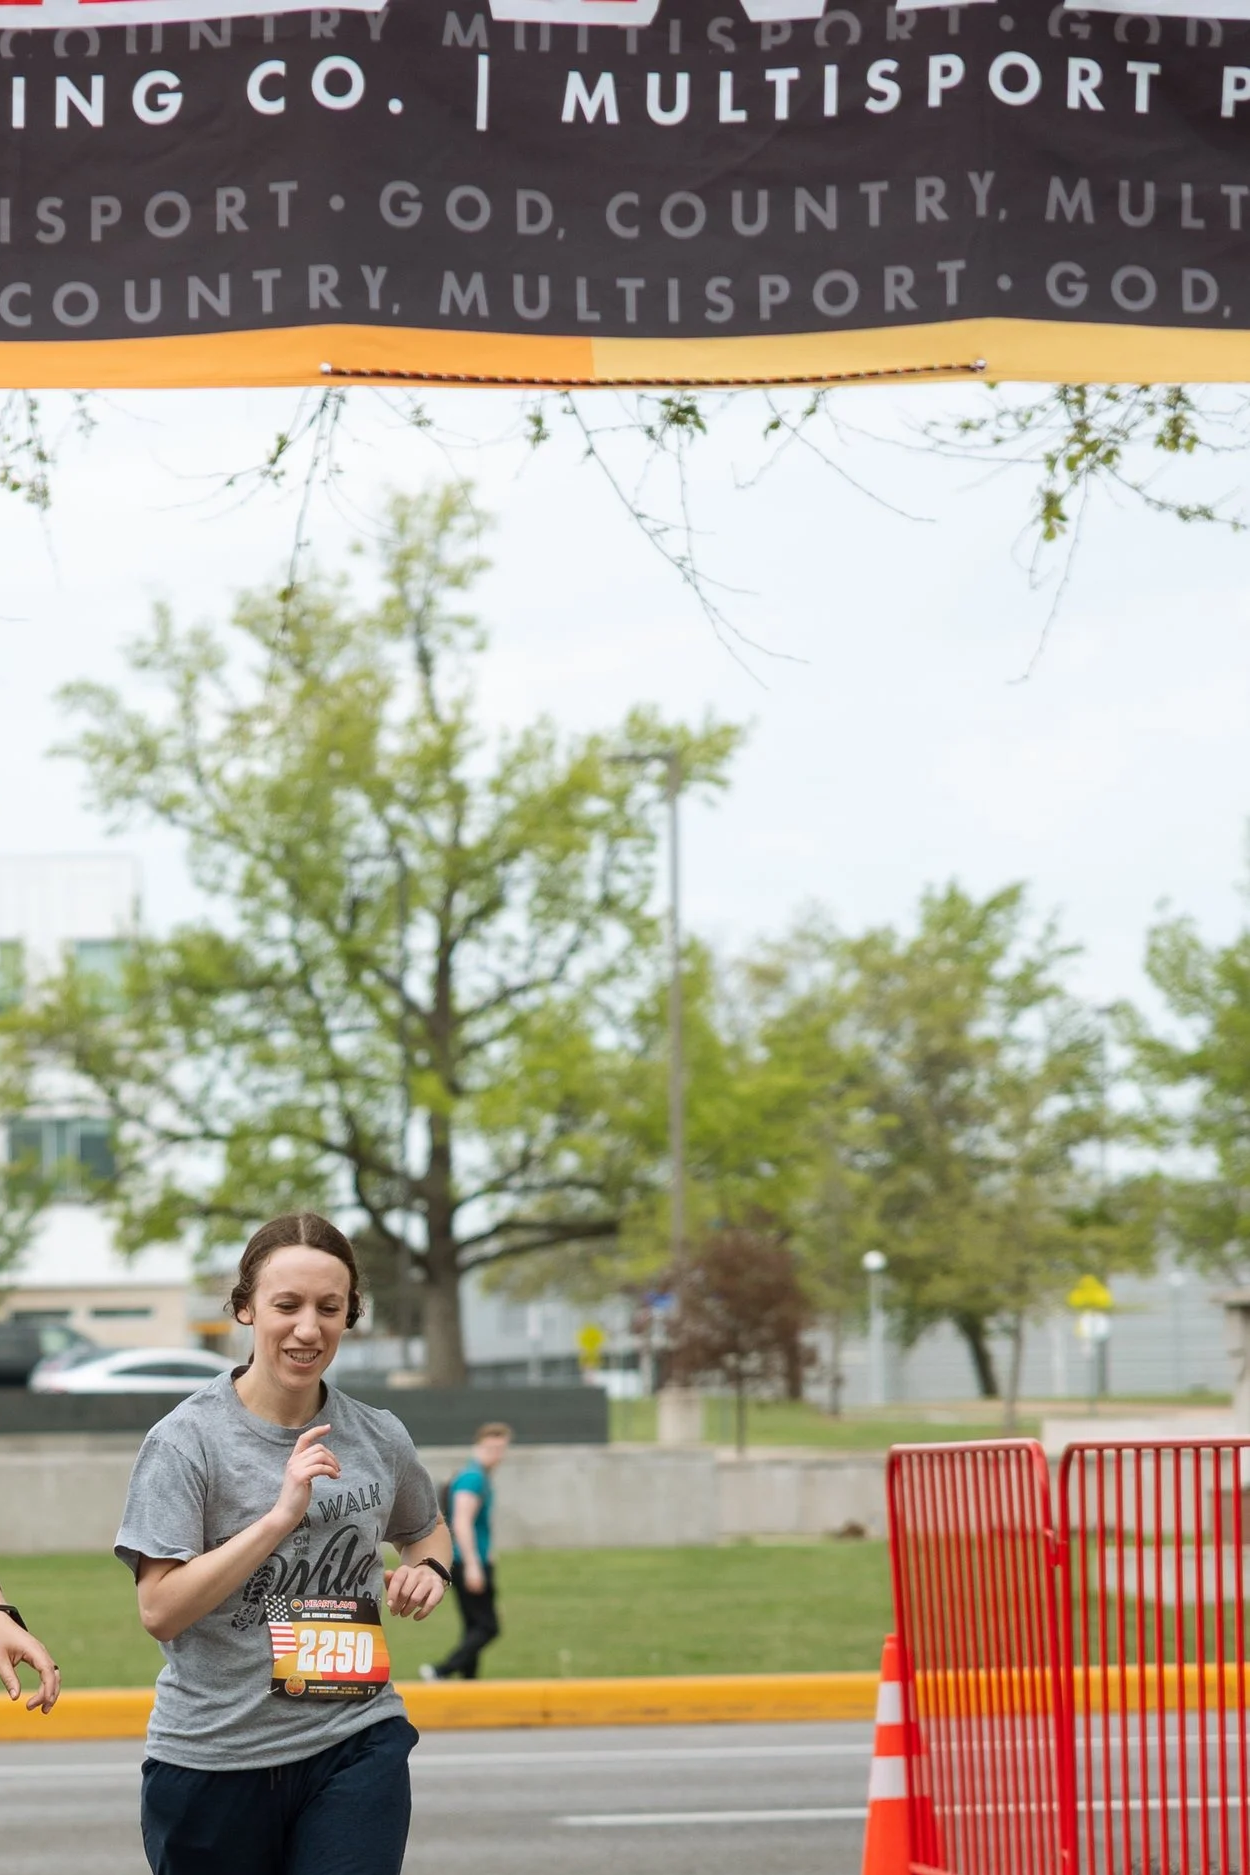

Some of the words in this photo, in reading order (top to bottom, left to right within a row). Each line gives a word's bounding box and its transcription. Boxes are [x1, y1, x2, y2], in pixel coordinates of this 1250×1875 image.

[246, 55, 403, 115] CO.
[561, 51, 1162, 125] MULTISPORT
[379, 180, 566, 240] GOD,
[605, 171, 1008, 240] COUNTRY,
[1045, 176, 1250, 230] MULT
[439, 259, 966, 324] MULTISPORT
[1046, 261, 1232, 318] GOD,
[317, 1482, 382, 1523] WALK
[293, 1534, 310, 1545] ON
[293, 1547, 310, 1556] THE
[304, 1600, 358, 1611] HEARTLAND
[296, 1629, 374, 1674] 2250
